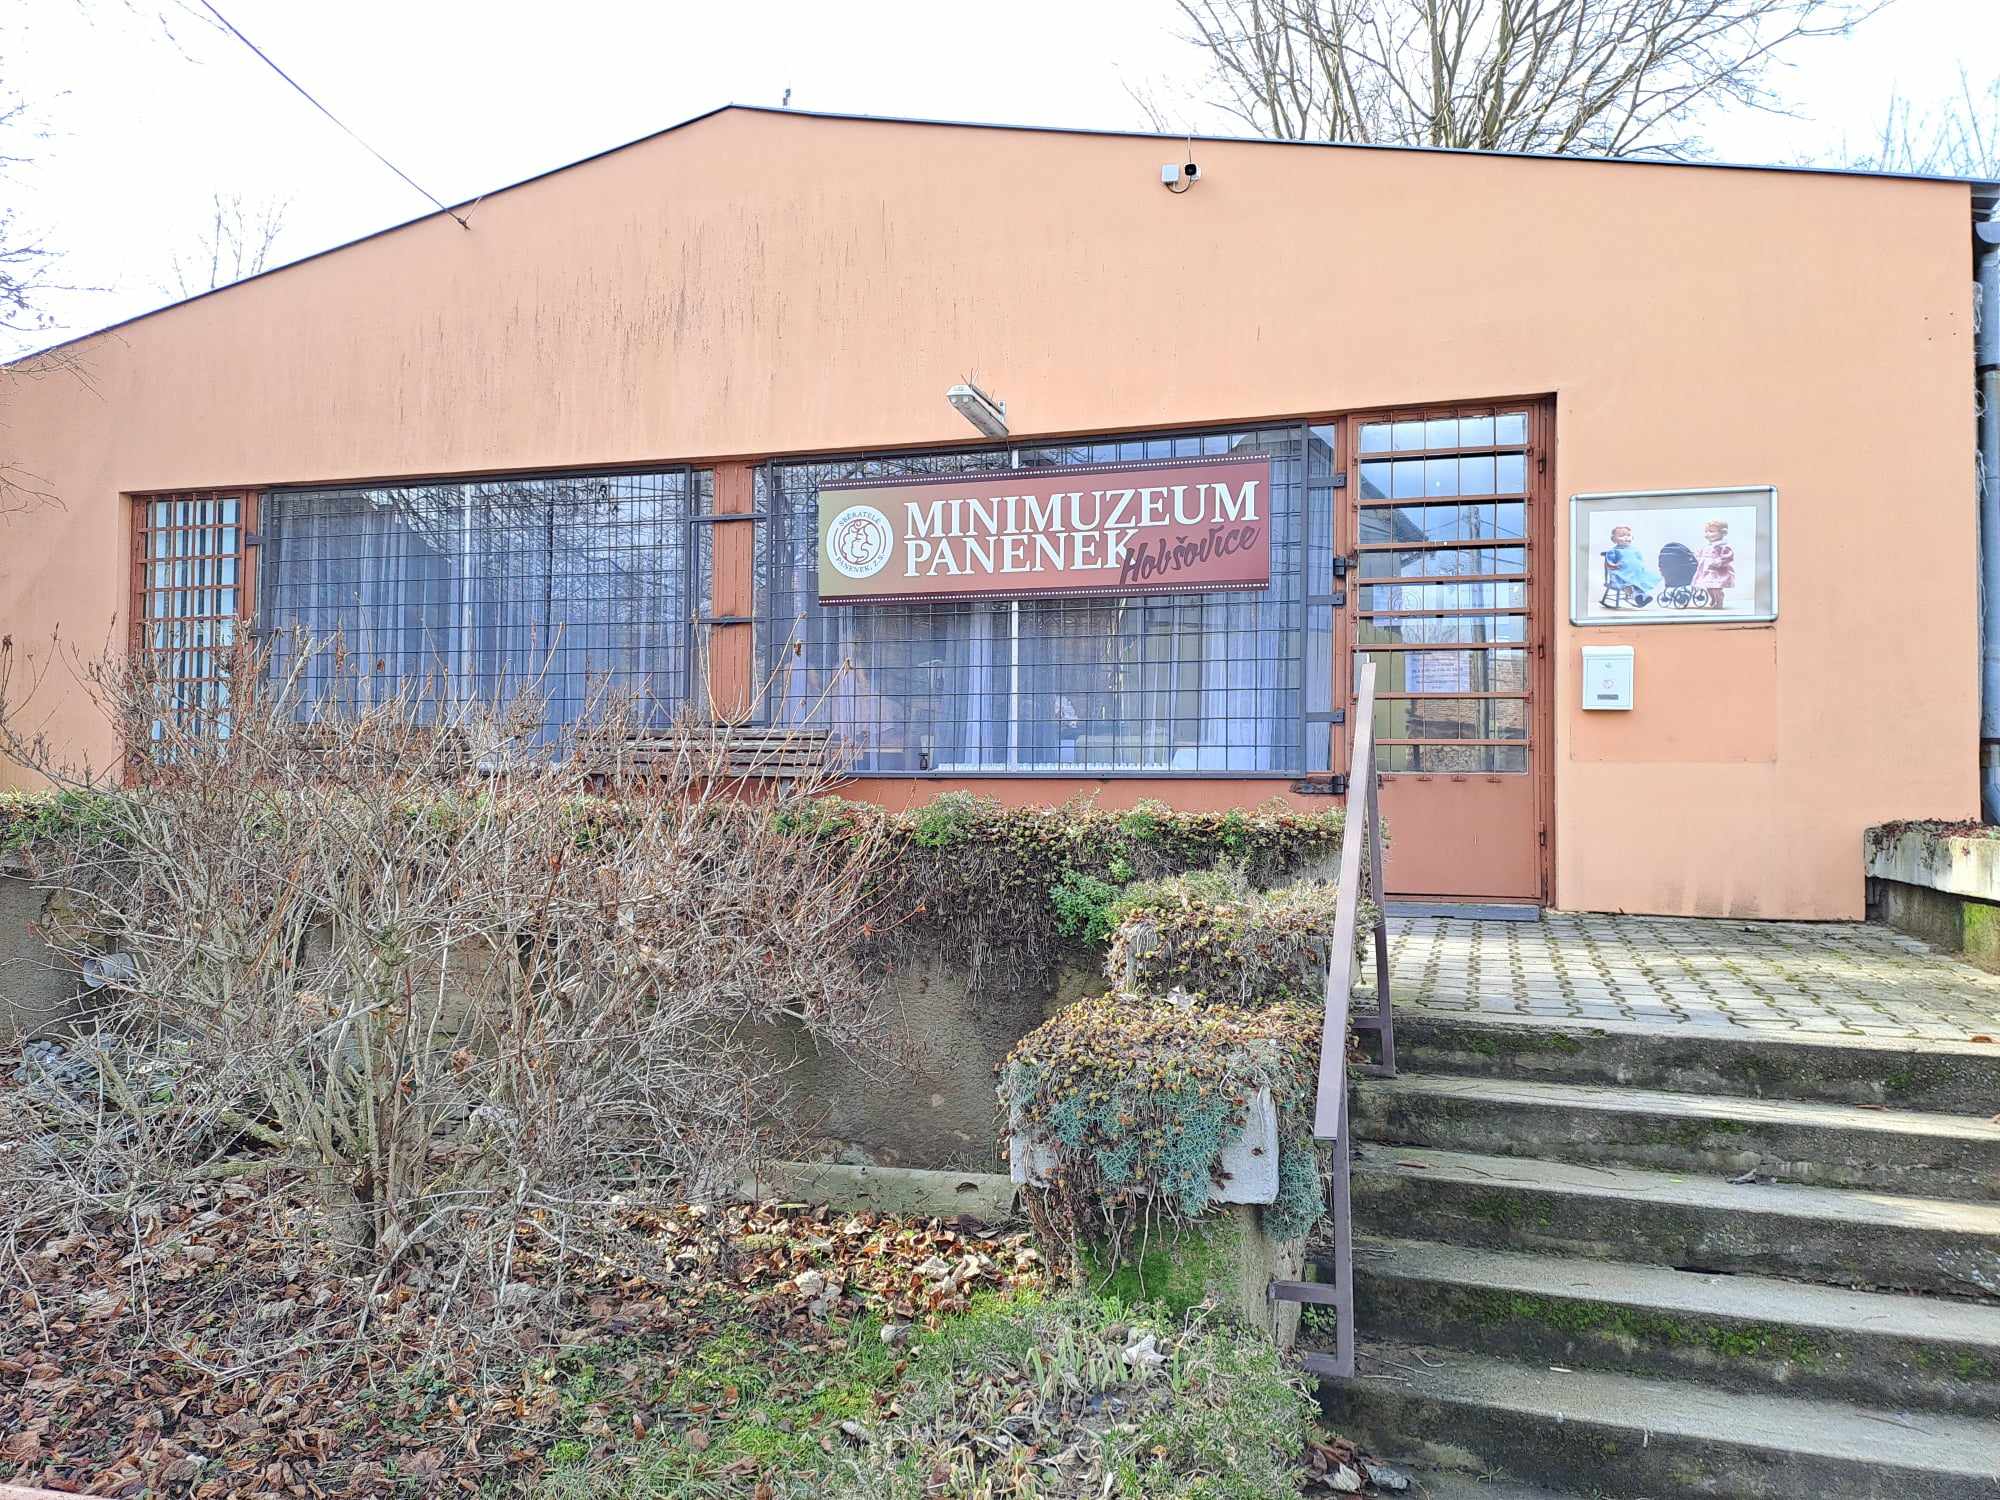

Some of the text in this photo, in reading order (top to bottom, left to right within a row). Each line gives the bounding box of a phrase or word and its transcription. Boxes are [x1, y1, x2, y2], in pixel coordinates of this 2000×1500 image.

[903, 480, 1260, 539] MINIMUZEUM
[903, 528, 1139, 577] PANENEK
[1119, 525, 1261, 586] Hobšovice
